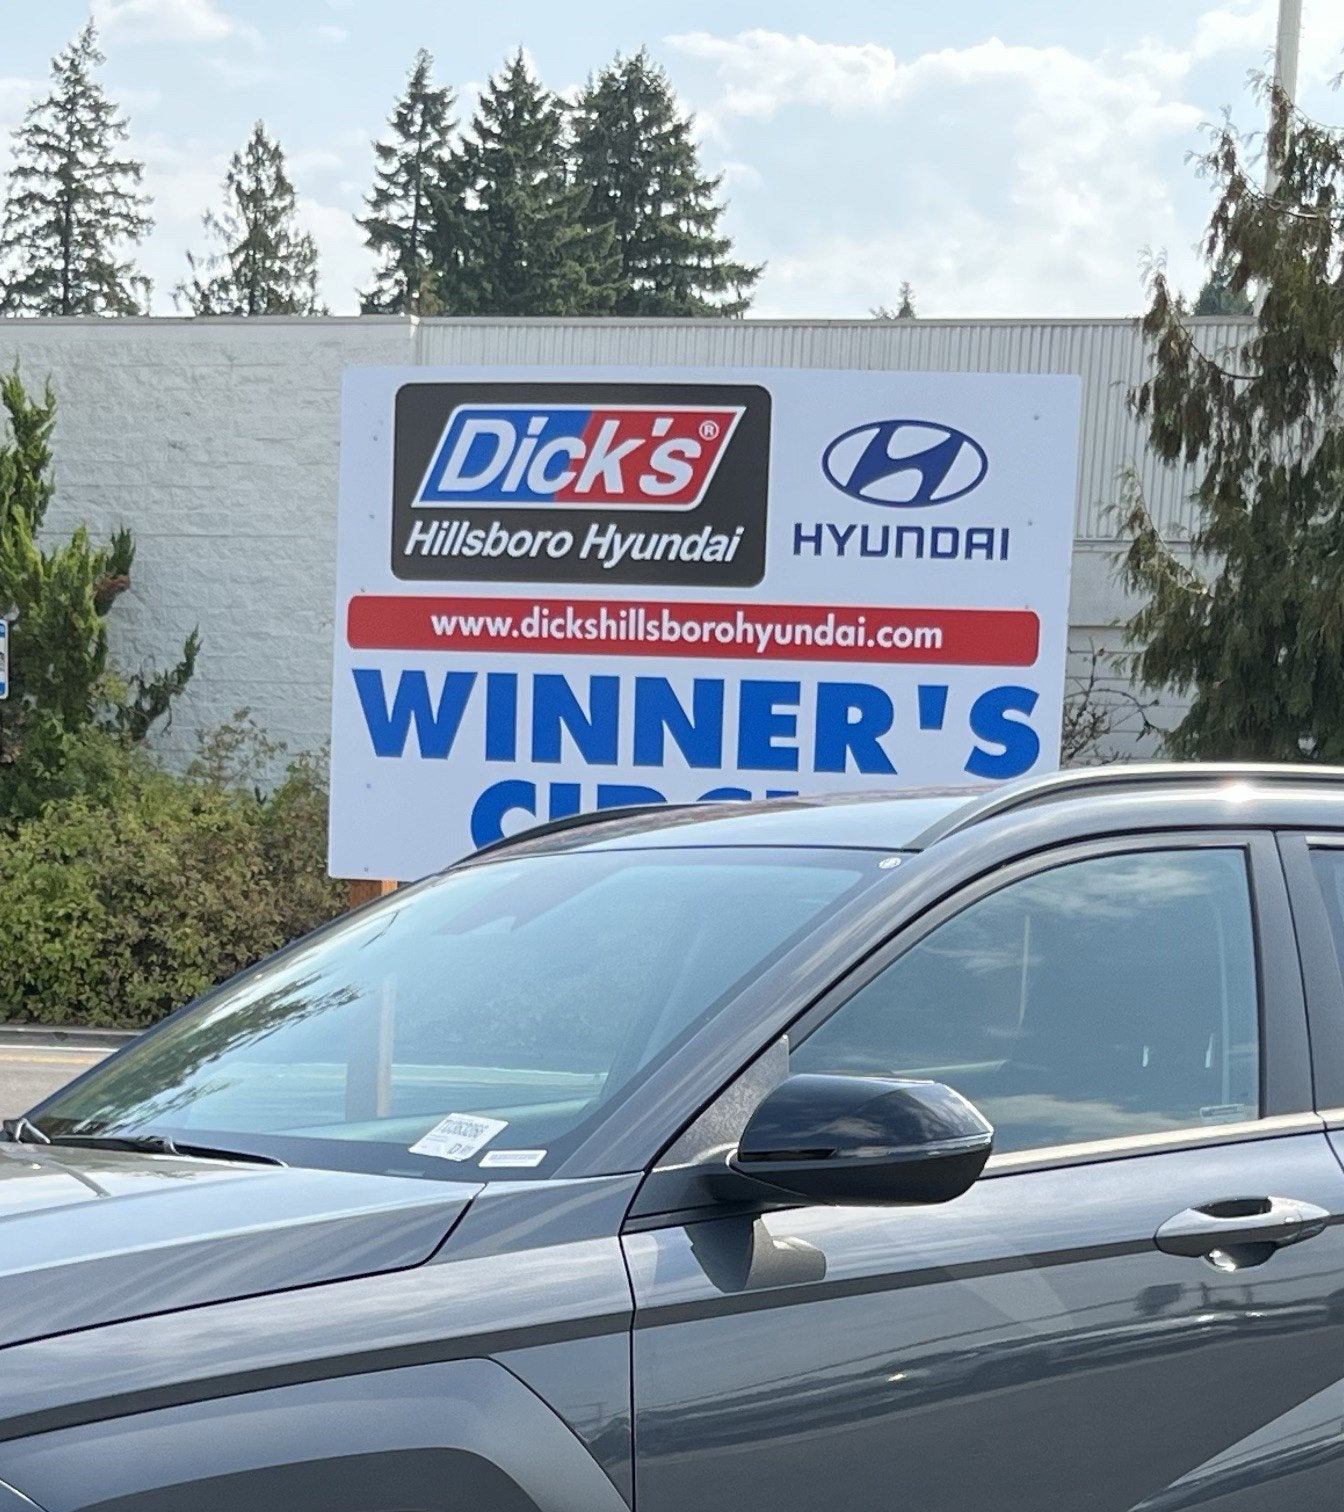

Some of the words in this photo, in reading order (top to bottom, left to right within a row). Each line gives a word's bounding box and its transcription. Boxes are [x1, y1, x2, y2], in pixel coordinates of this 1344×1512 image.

[403, 520, 574, 559] Hillsboro
[579, 523, 746, 570] Hyundai
[793, 522, 1010, 561] HYUNDAI
[430, 607, 943, 651] www.dickshillsborohyundai.com
[352, 668, 1040, 778] WINNER'S
